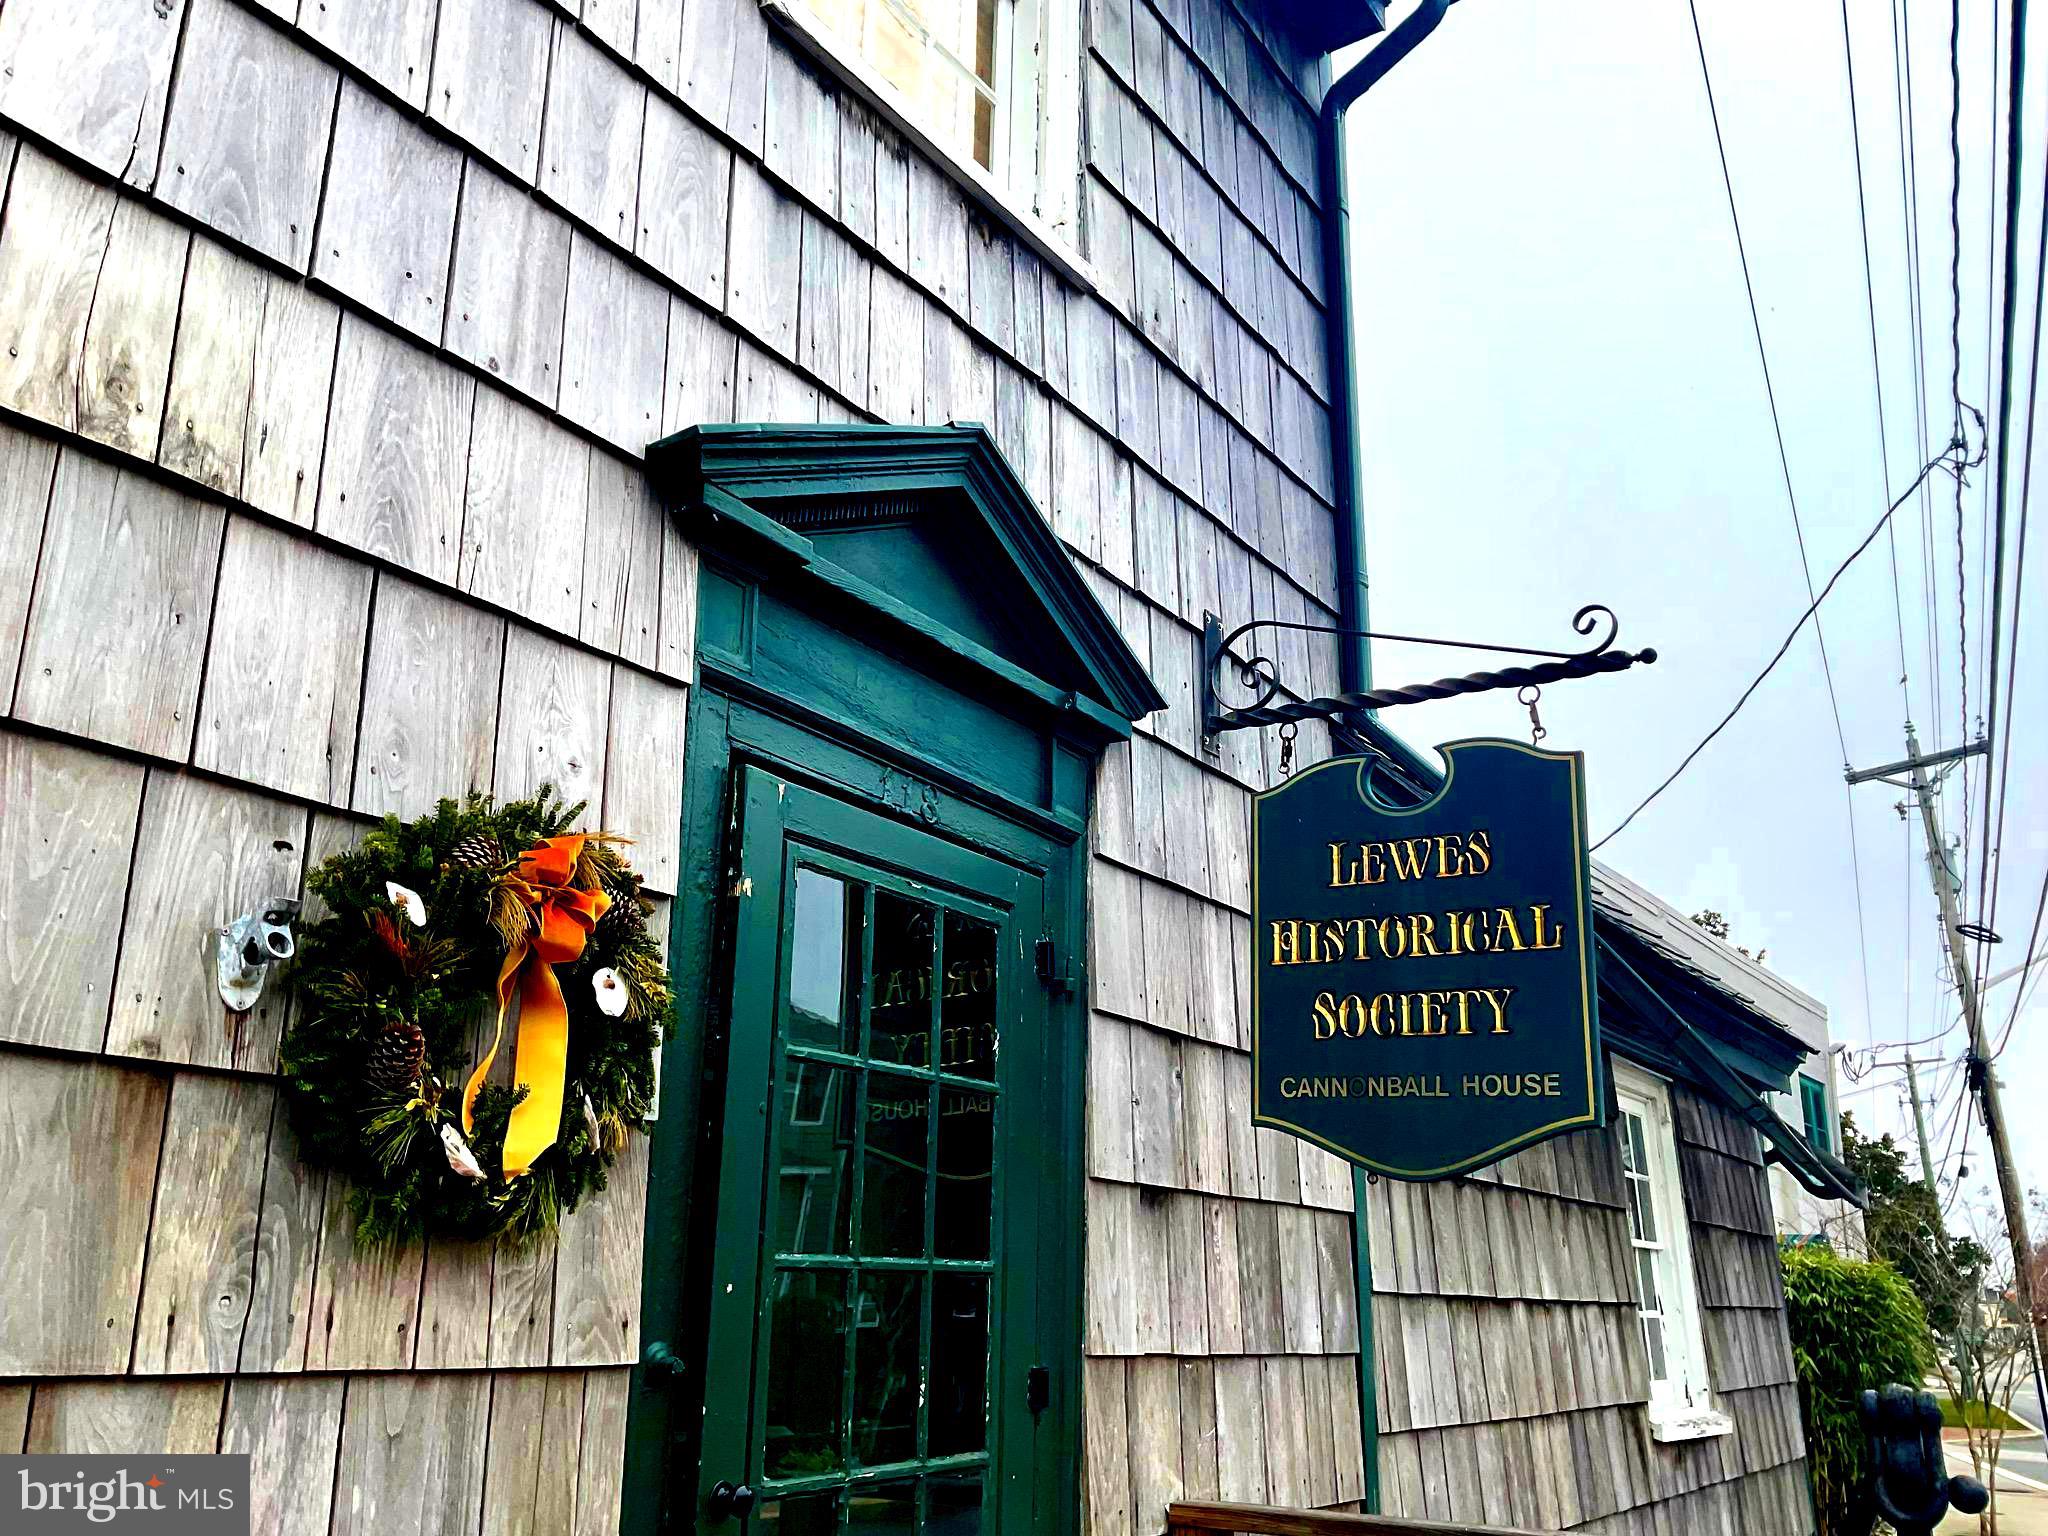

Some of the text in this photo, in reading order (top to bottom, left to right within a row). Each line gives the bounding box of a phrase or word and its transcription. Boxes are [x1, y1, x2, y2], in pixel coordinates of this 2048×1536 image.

[879, 767, 939, 824] 118
[1328, 831, 1491, 888] LEWES
[1270, 904, 1563, 966] HISTORICAL
[1312, 987, 1514, 1040] SOCIETY
[1280, 1073, 1561, 1098] CANNONBALL HOUSE
